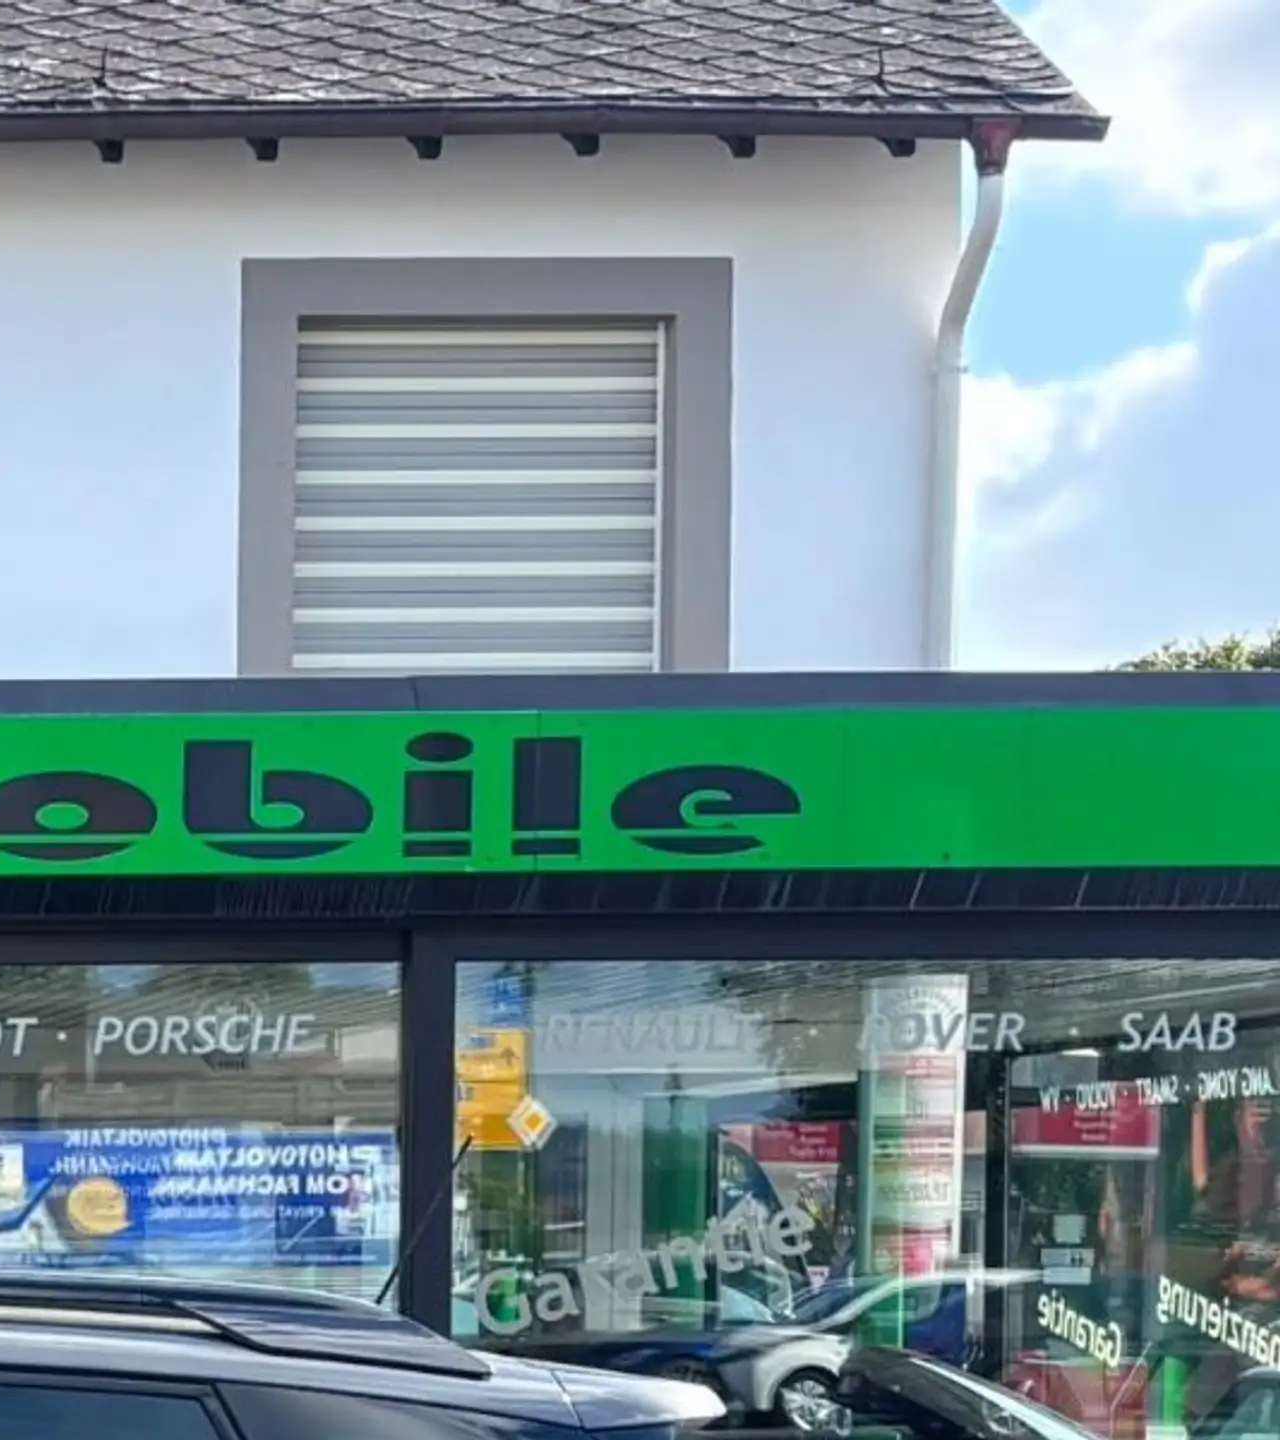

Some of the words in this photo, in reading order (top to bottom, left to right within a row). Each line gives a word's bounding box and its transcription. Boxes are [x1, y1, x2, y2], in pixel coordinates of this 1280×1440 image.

[93, 1013, 316, 1056] PORSCHE
[856, 1011, 1026, 1052] ROVER
[1117, 1011, 1237, 1052] SAAB
